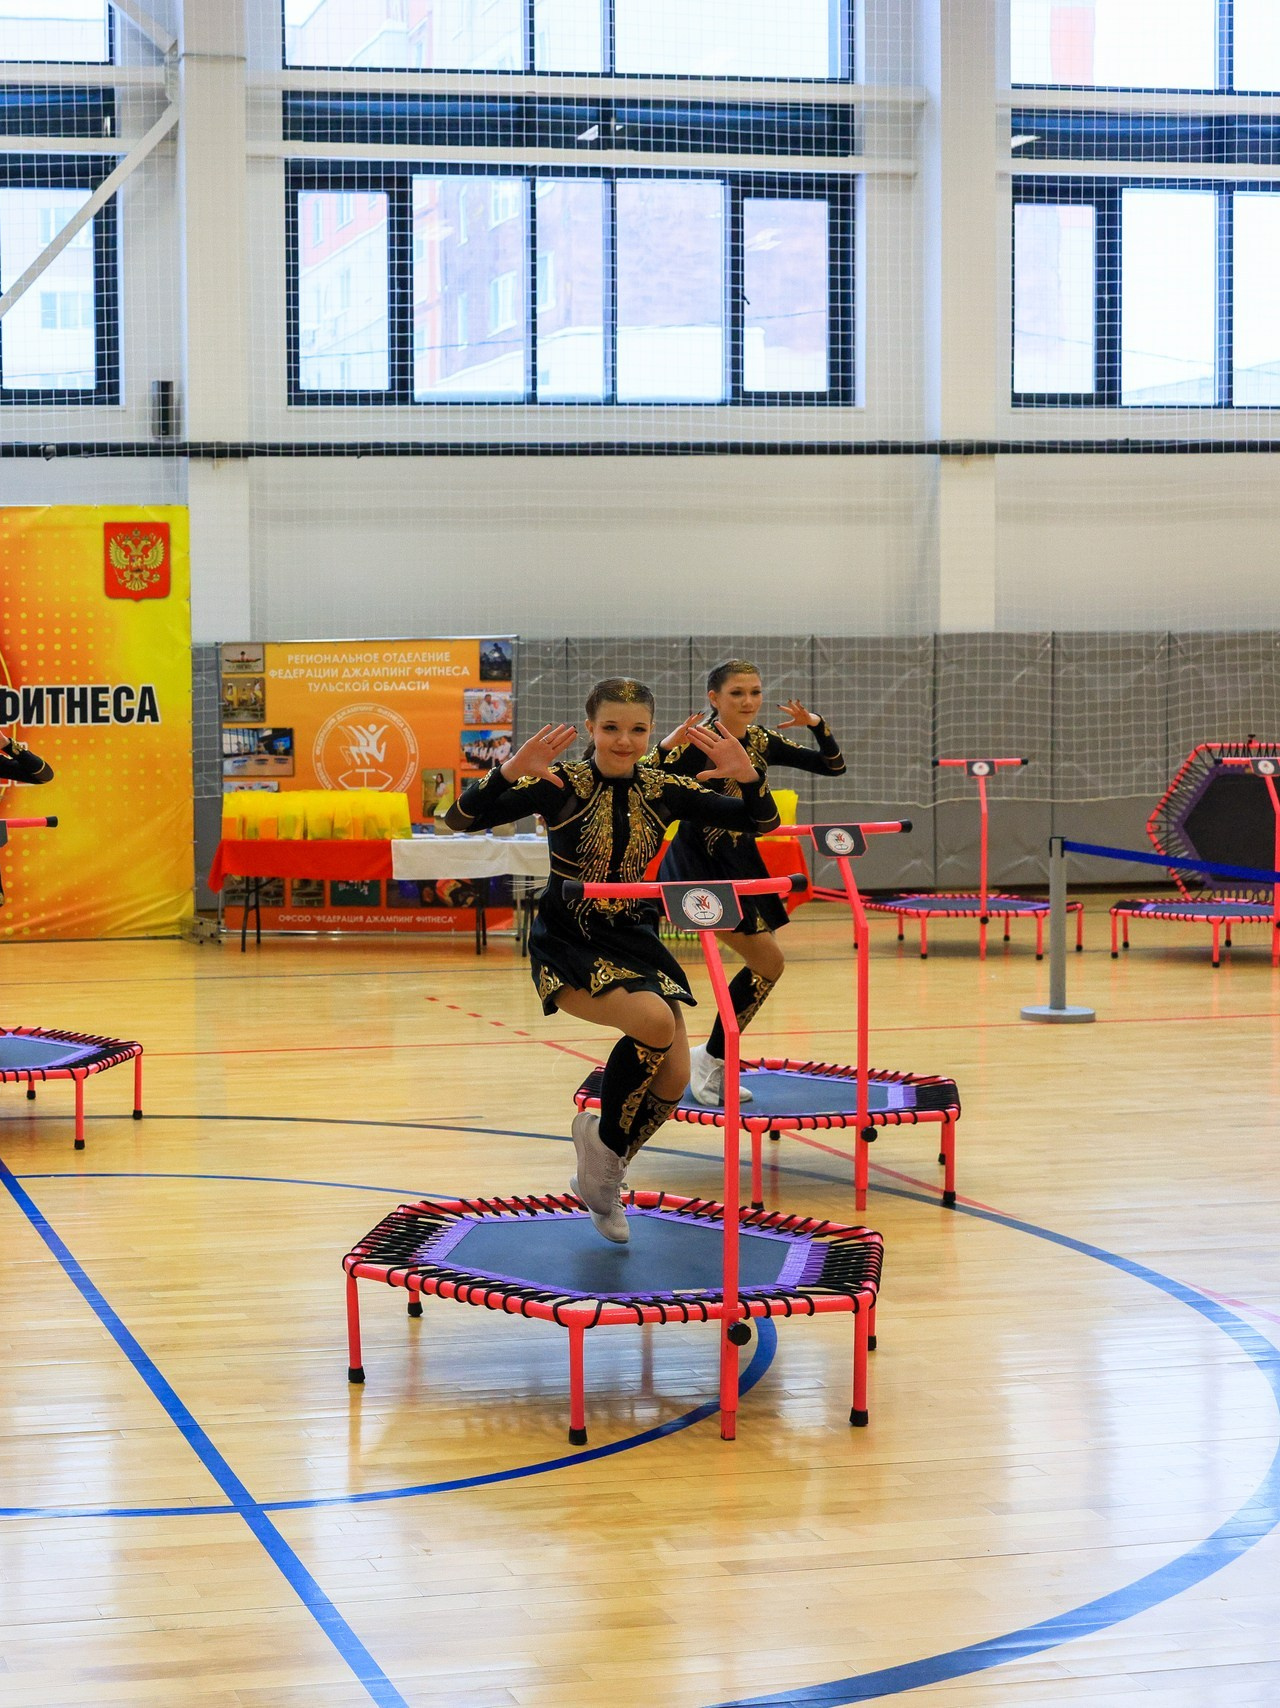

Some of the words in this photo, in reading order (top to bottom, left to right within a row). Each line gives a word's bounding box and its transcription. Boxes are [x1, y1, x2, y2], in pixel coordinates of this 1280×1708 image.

[287, 653, 379, 664] РЕГИОНАЛЬНОЕ
[382, 651, 451, 663] ОТДЕЛЕНИЕ
[268, 668, 339, 679] ФЕДЕРАЦИИ
[341, 667, 412, 679] ДЖАМПИНГ
[414, 665, 471, 677] ФИТНЕСА
[308, 680, 370, 692] ТУЛЬСКОЙ
[373, 681, 430, 692] ОБЛАСТИ
